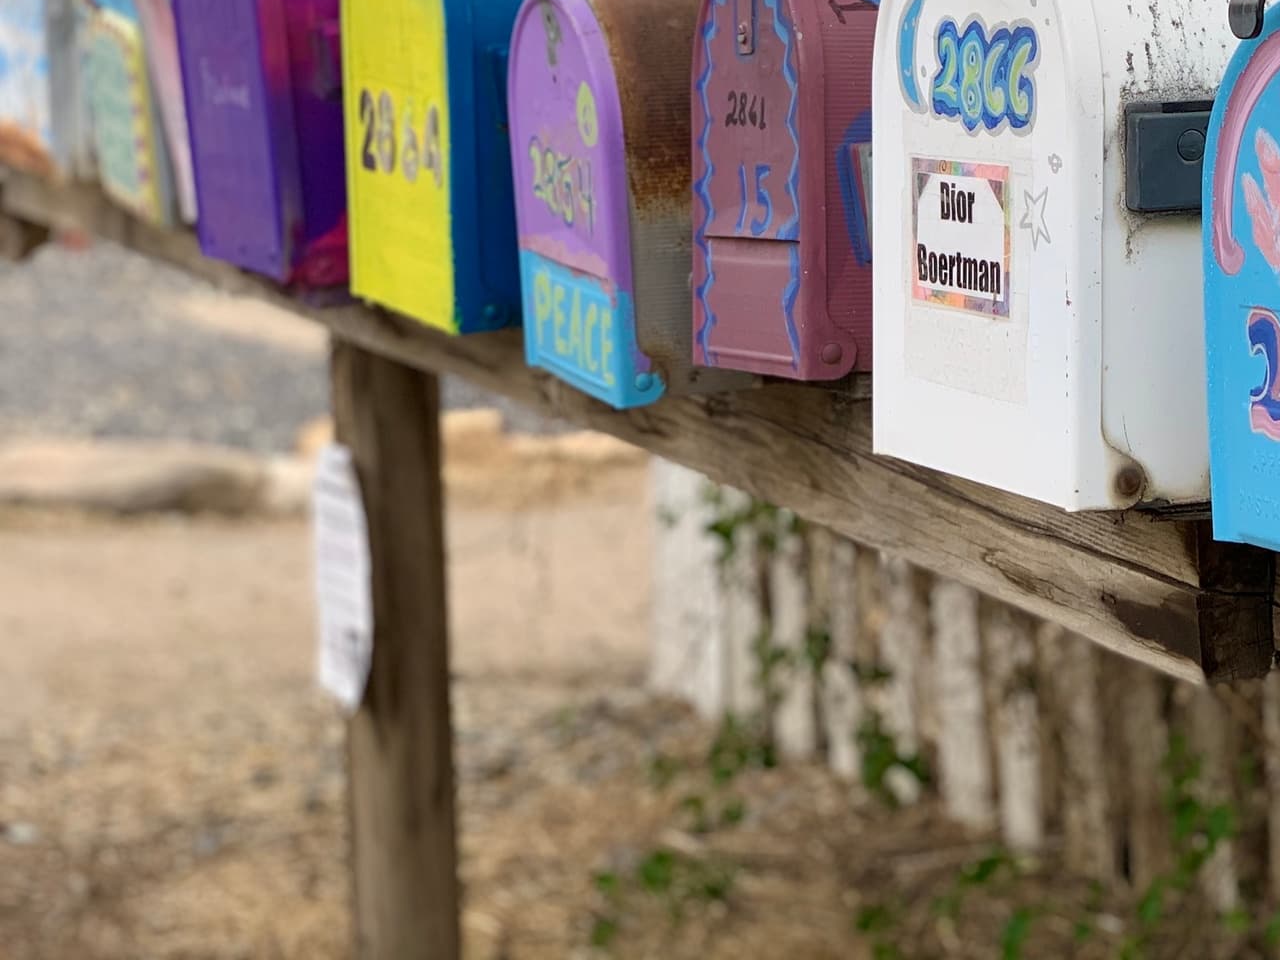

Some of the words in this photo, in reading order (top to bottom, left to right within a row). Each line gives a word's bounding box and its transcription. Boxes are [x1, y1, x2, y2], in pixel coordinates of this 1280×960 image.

[932, 17, 1039, 133] 2866
[725, 90, 766, 130] 2861
[735, 160, 773, 236] 15
[940, 181, 976, 224] Dior
[917, 243, 1001, 295] Boertman
[534, 270, 615, 387] PEACE
